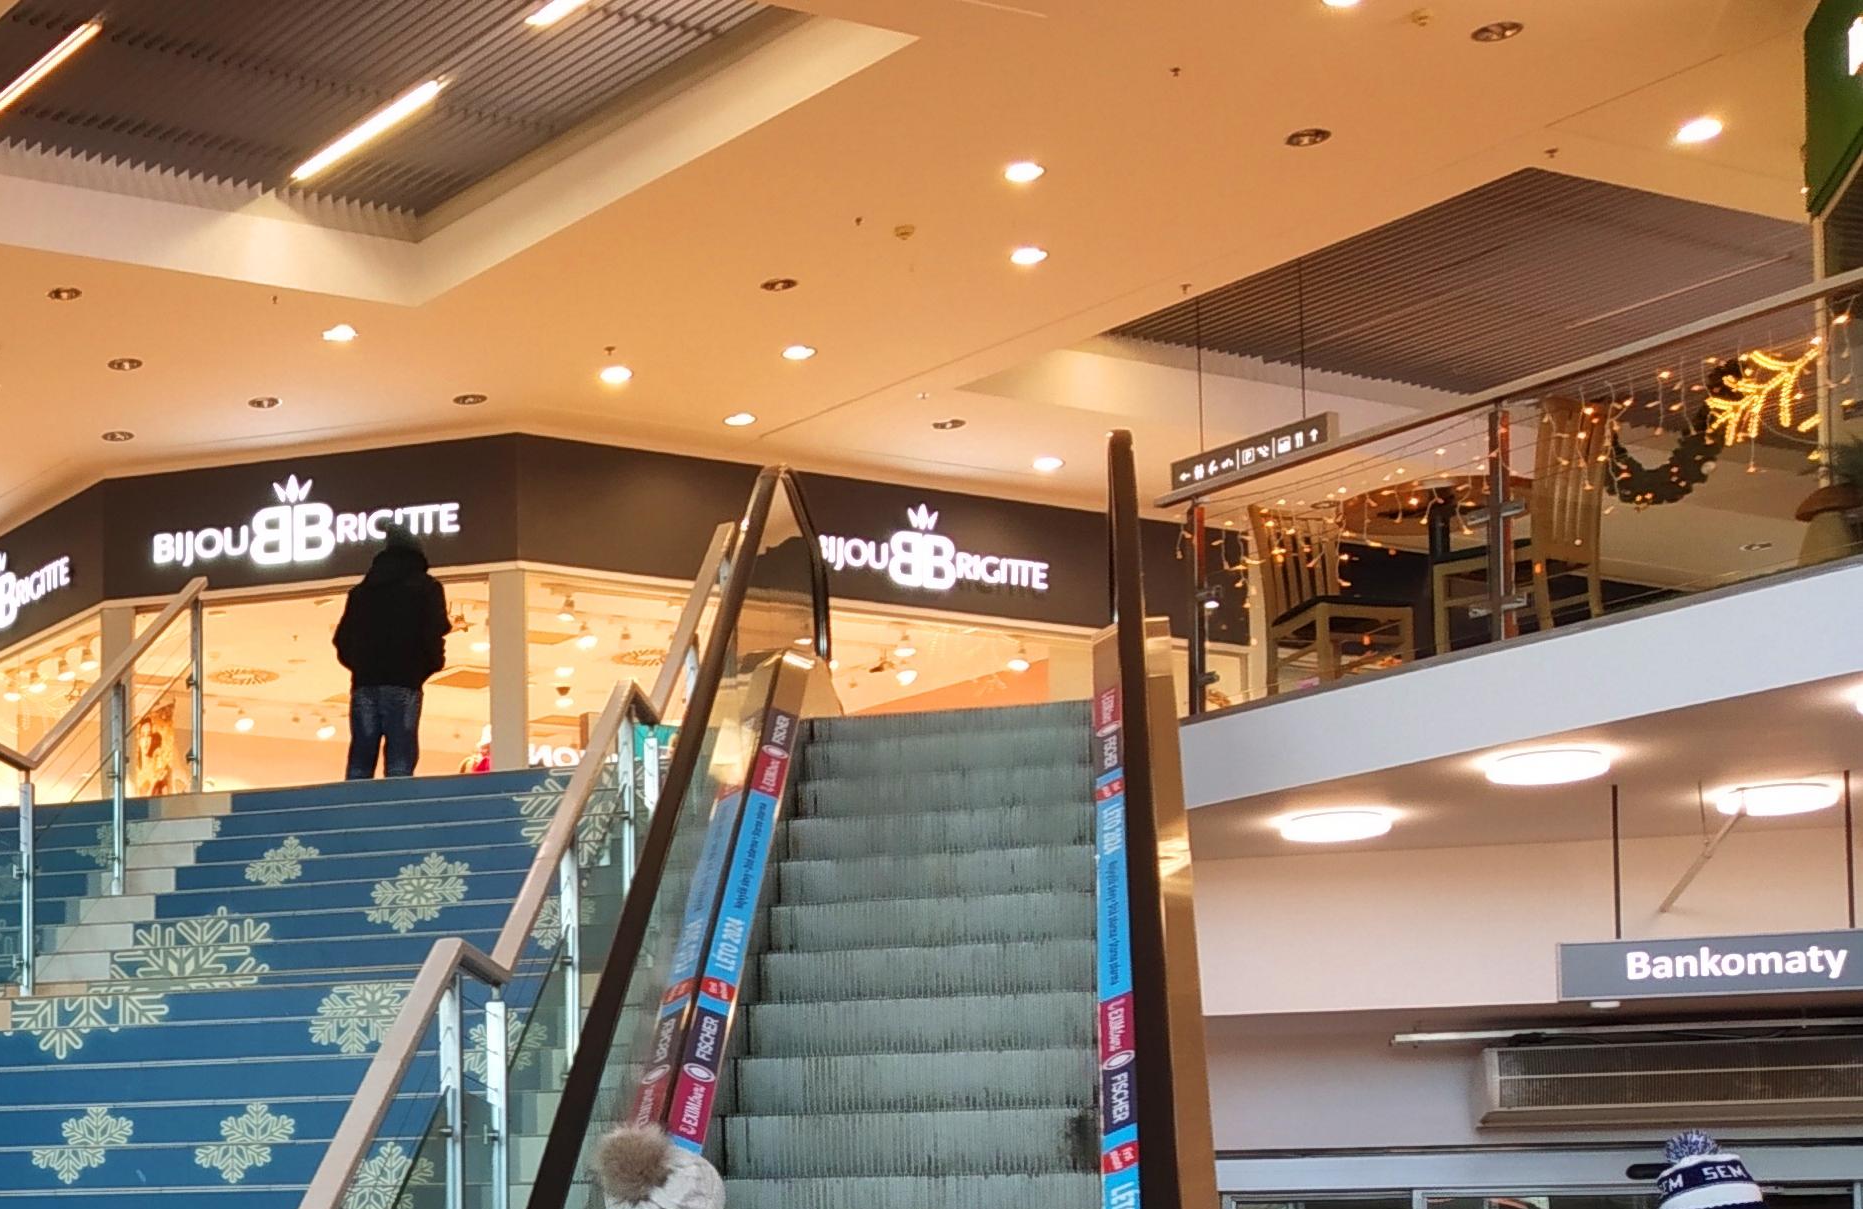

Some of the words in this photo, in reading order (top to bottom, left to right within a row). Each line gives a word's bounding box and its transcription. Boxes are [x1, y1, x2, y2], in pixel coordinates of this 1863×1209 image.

[153, 525, 249, 566] BIJOU
[1626, 946, 1848, 980] Bankomaty
[695, 1016, 720, 1062] FISCHER
[1111, 1071, 1130, 1124] FISCHER
